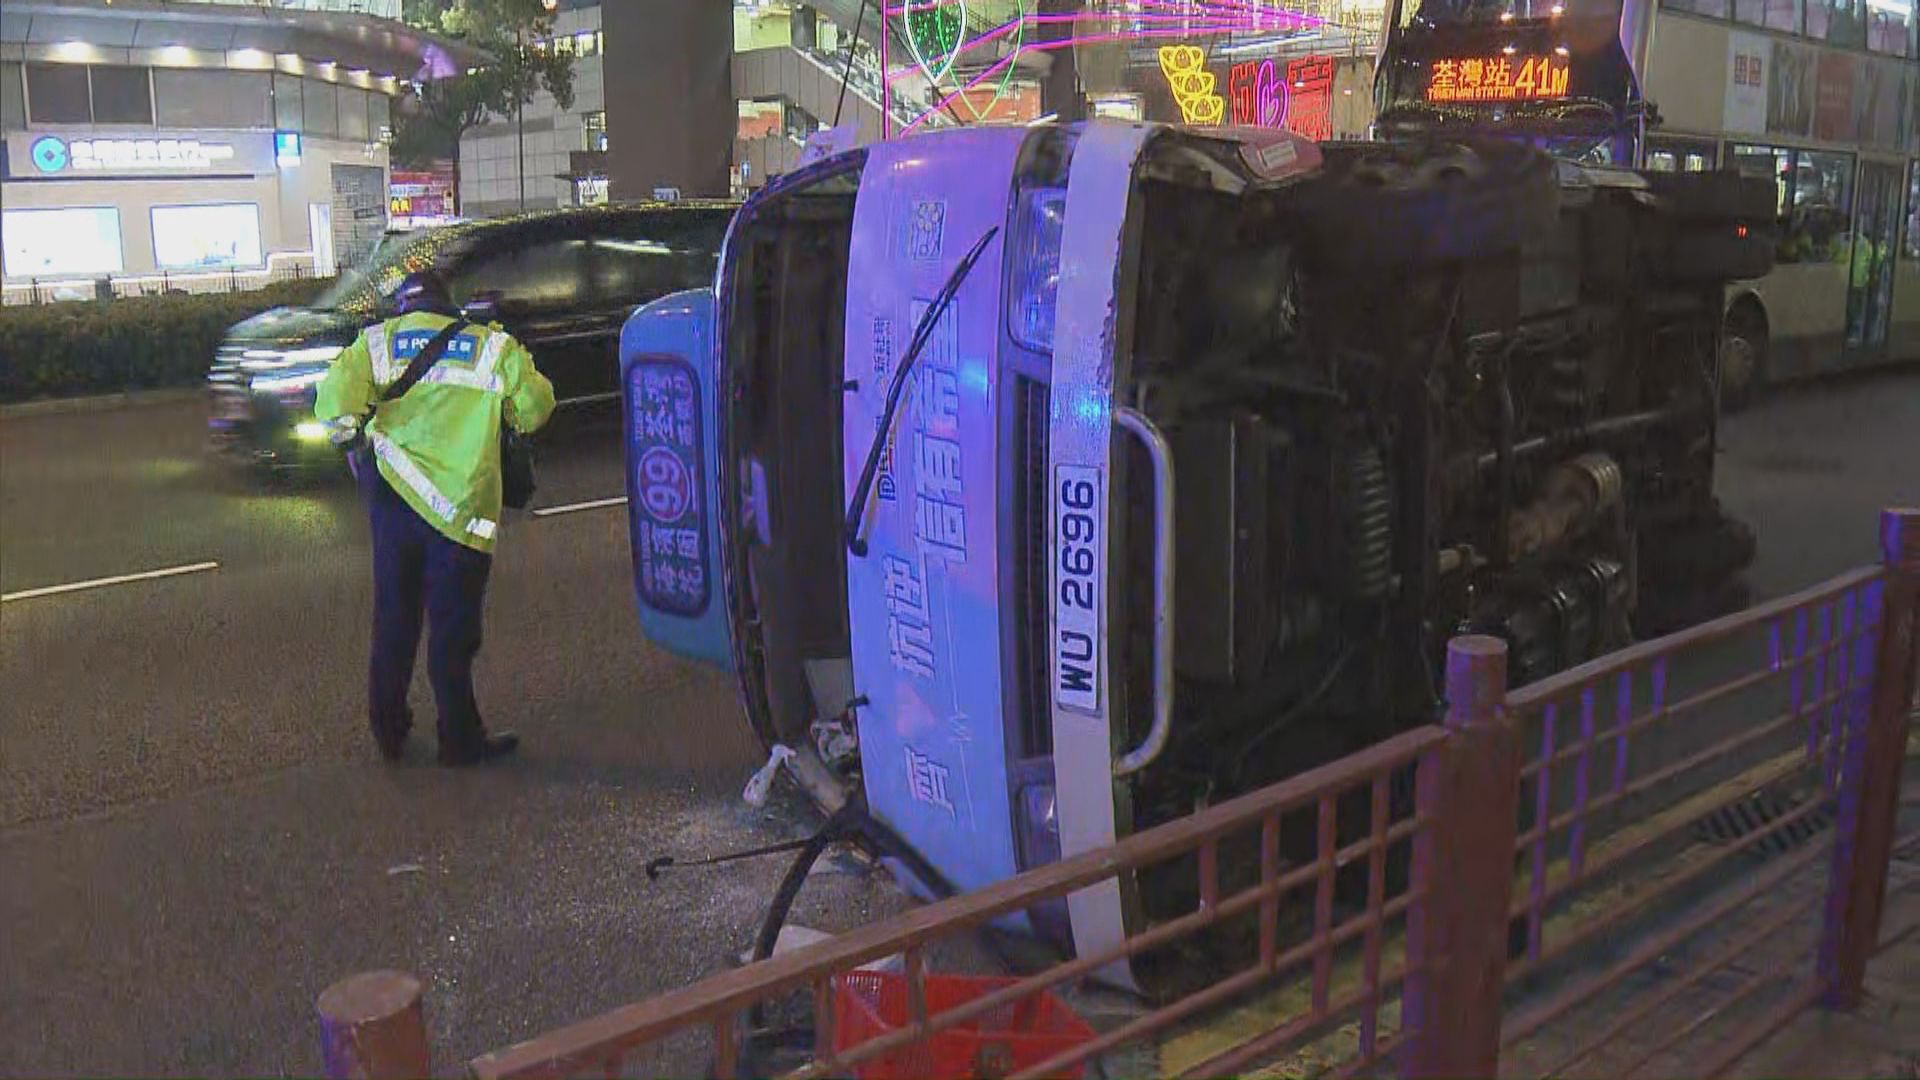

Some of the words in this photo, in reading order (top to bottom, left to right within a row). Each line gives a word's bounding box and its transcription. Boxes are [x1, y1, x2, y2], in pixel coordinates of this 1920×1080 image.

[1431, 57, 1511, 87] 荃灣站
[1517, 57, 1569, 96] 41M
[646, 458, 682, 512] 99
[1061, 479, 1094, 610] 2696
[882, 552, 937, 682] 抗逆
[1061, 630, 1093, 692] WU
